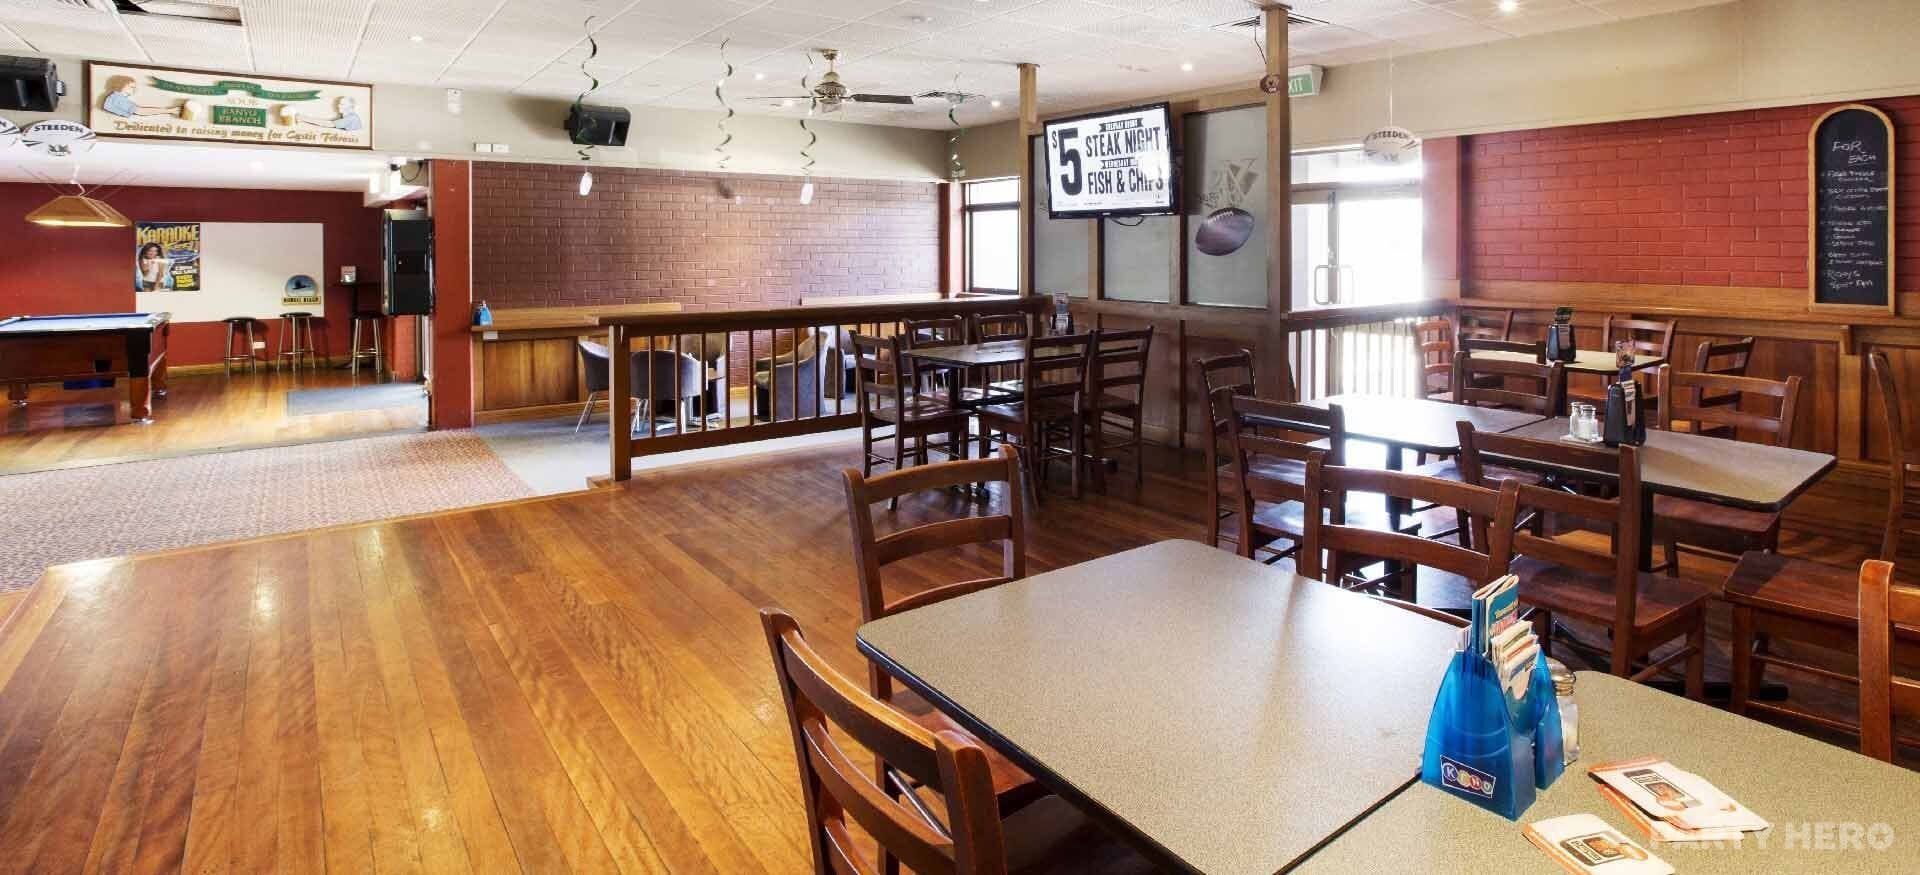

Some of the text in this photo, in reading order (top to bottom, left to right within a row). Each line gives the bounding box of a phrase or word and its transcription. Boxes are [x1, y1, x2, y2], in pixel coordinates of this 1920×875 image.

[1288, 77, 1304, 94] XIT
[34, 124, 84, 133] STEEDEN
[114, 120, 172, 134] Dedicated
[176, 125, 187, 134] to
[192, 127, 227, 137] raising
[231, 130, 263, 140] money
[268, 129, 282, 140] for
[1085, 126, 1161, 157] STEAK NIGHT
[1087, 170, 1113, 195] FISH
[1117, 169, 1125, 192] &
